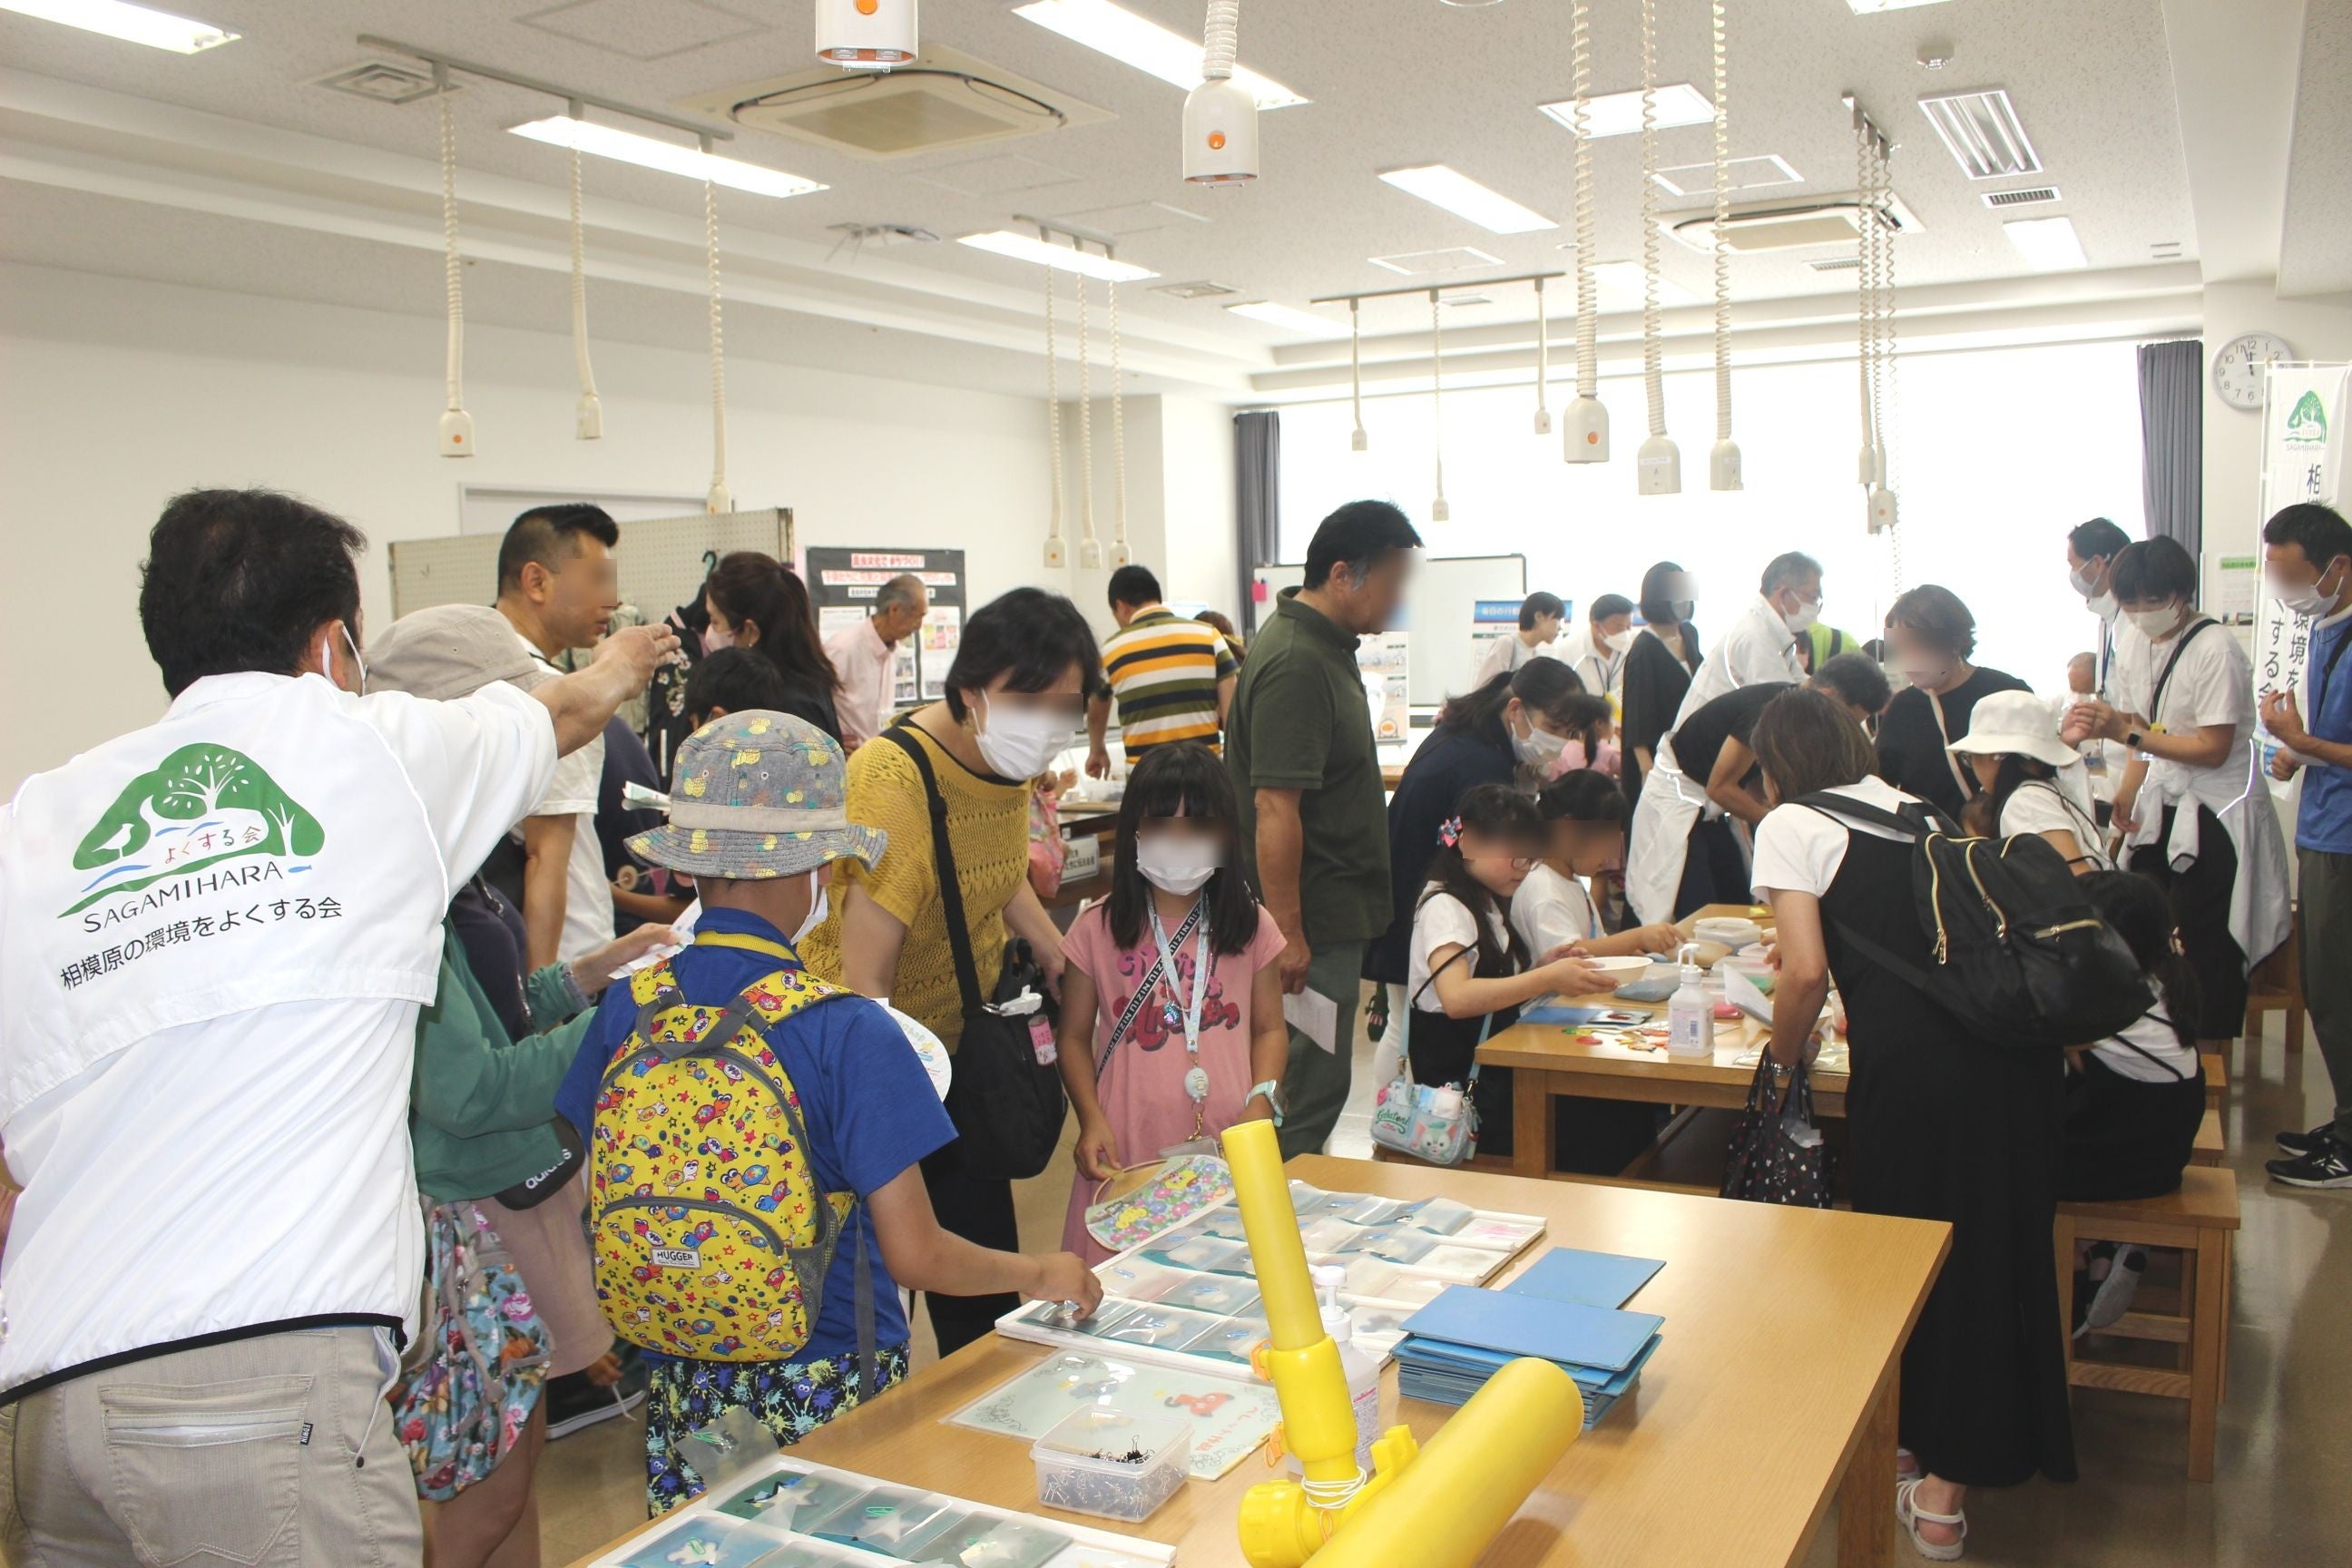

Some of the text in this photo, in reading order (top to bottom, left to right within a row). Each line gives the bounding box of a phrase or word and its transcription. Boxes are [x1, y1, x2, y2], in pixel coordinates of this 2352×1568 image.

[2248, 339, 2257, 349] 12
[2225, 355, 2234, 364] 10
[2273, 351, 2280, 361] 2
[2219, 367, 2225, 377] 9
[2224, 380, 2230, 390] 8
[2235, 388, 2241, 399] 7
[2248, 391, 2255, 400] 6
[2307, 463, 2321, 504] 相
[165, 826, 262, 864] よくする会
[83, 861, 284, 934] SAGAMIHARA
[60, 897, 343, 991] 相模原の環境をよくする会
[1130, 983, 1150, 1011] NIZIU
[657, 1251, 693, 1260] HUGGER
